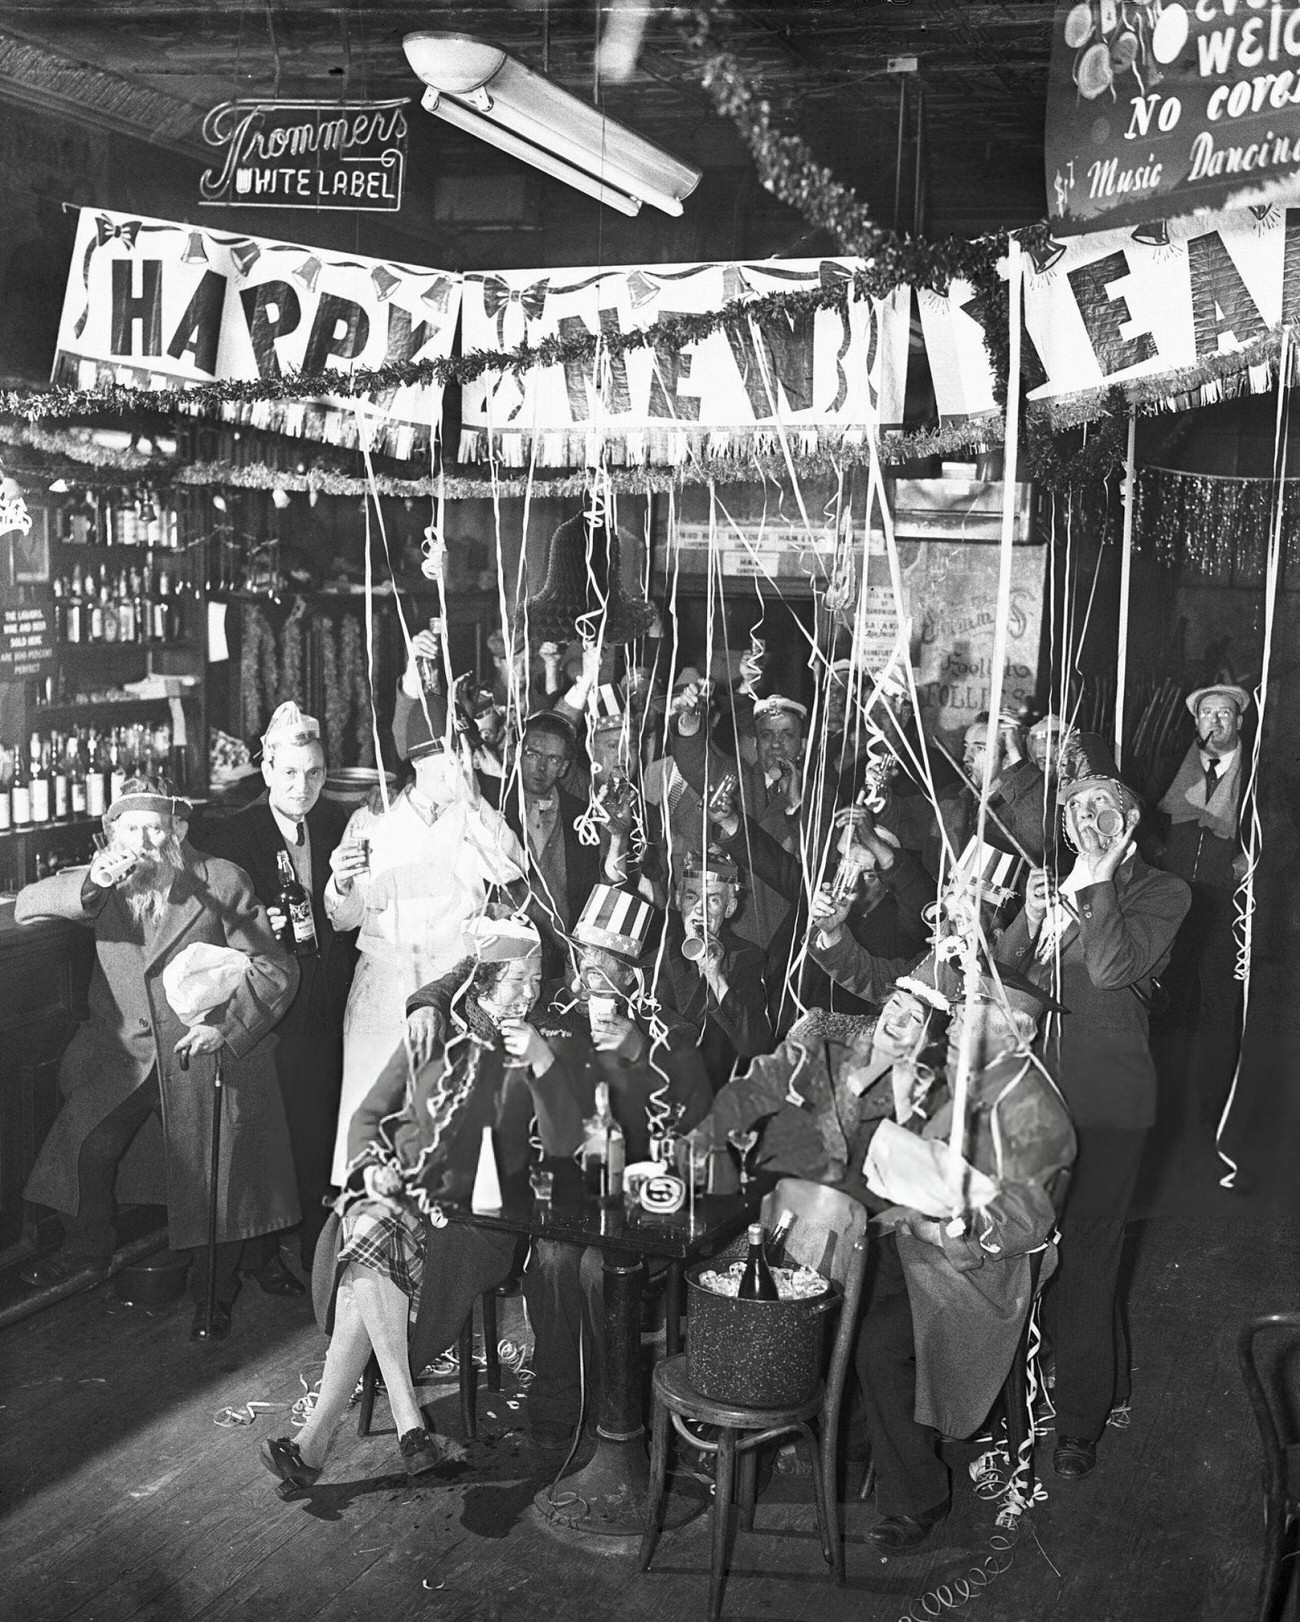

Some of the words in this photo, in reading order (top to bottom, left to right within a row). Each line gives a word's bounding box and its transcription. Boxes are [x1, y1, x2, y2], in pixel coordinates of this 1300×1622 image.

[236, 168, 311, 196] WHITE
[317, 169, 396, 199] LABEL
[1088, 153, 1163, 199] Music
[111, 259, 441, 412] HAPPY
[558, 296, 815, 422] NEW
[960, 208, 1300, 391] YEA
